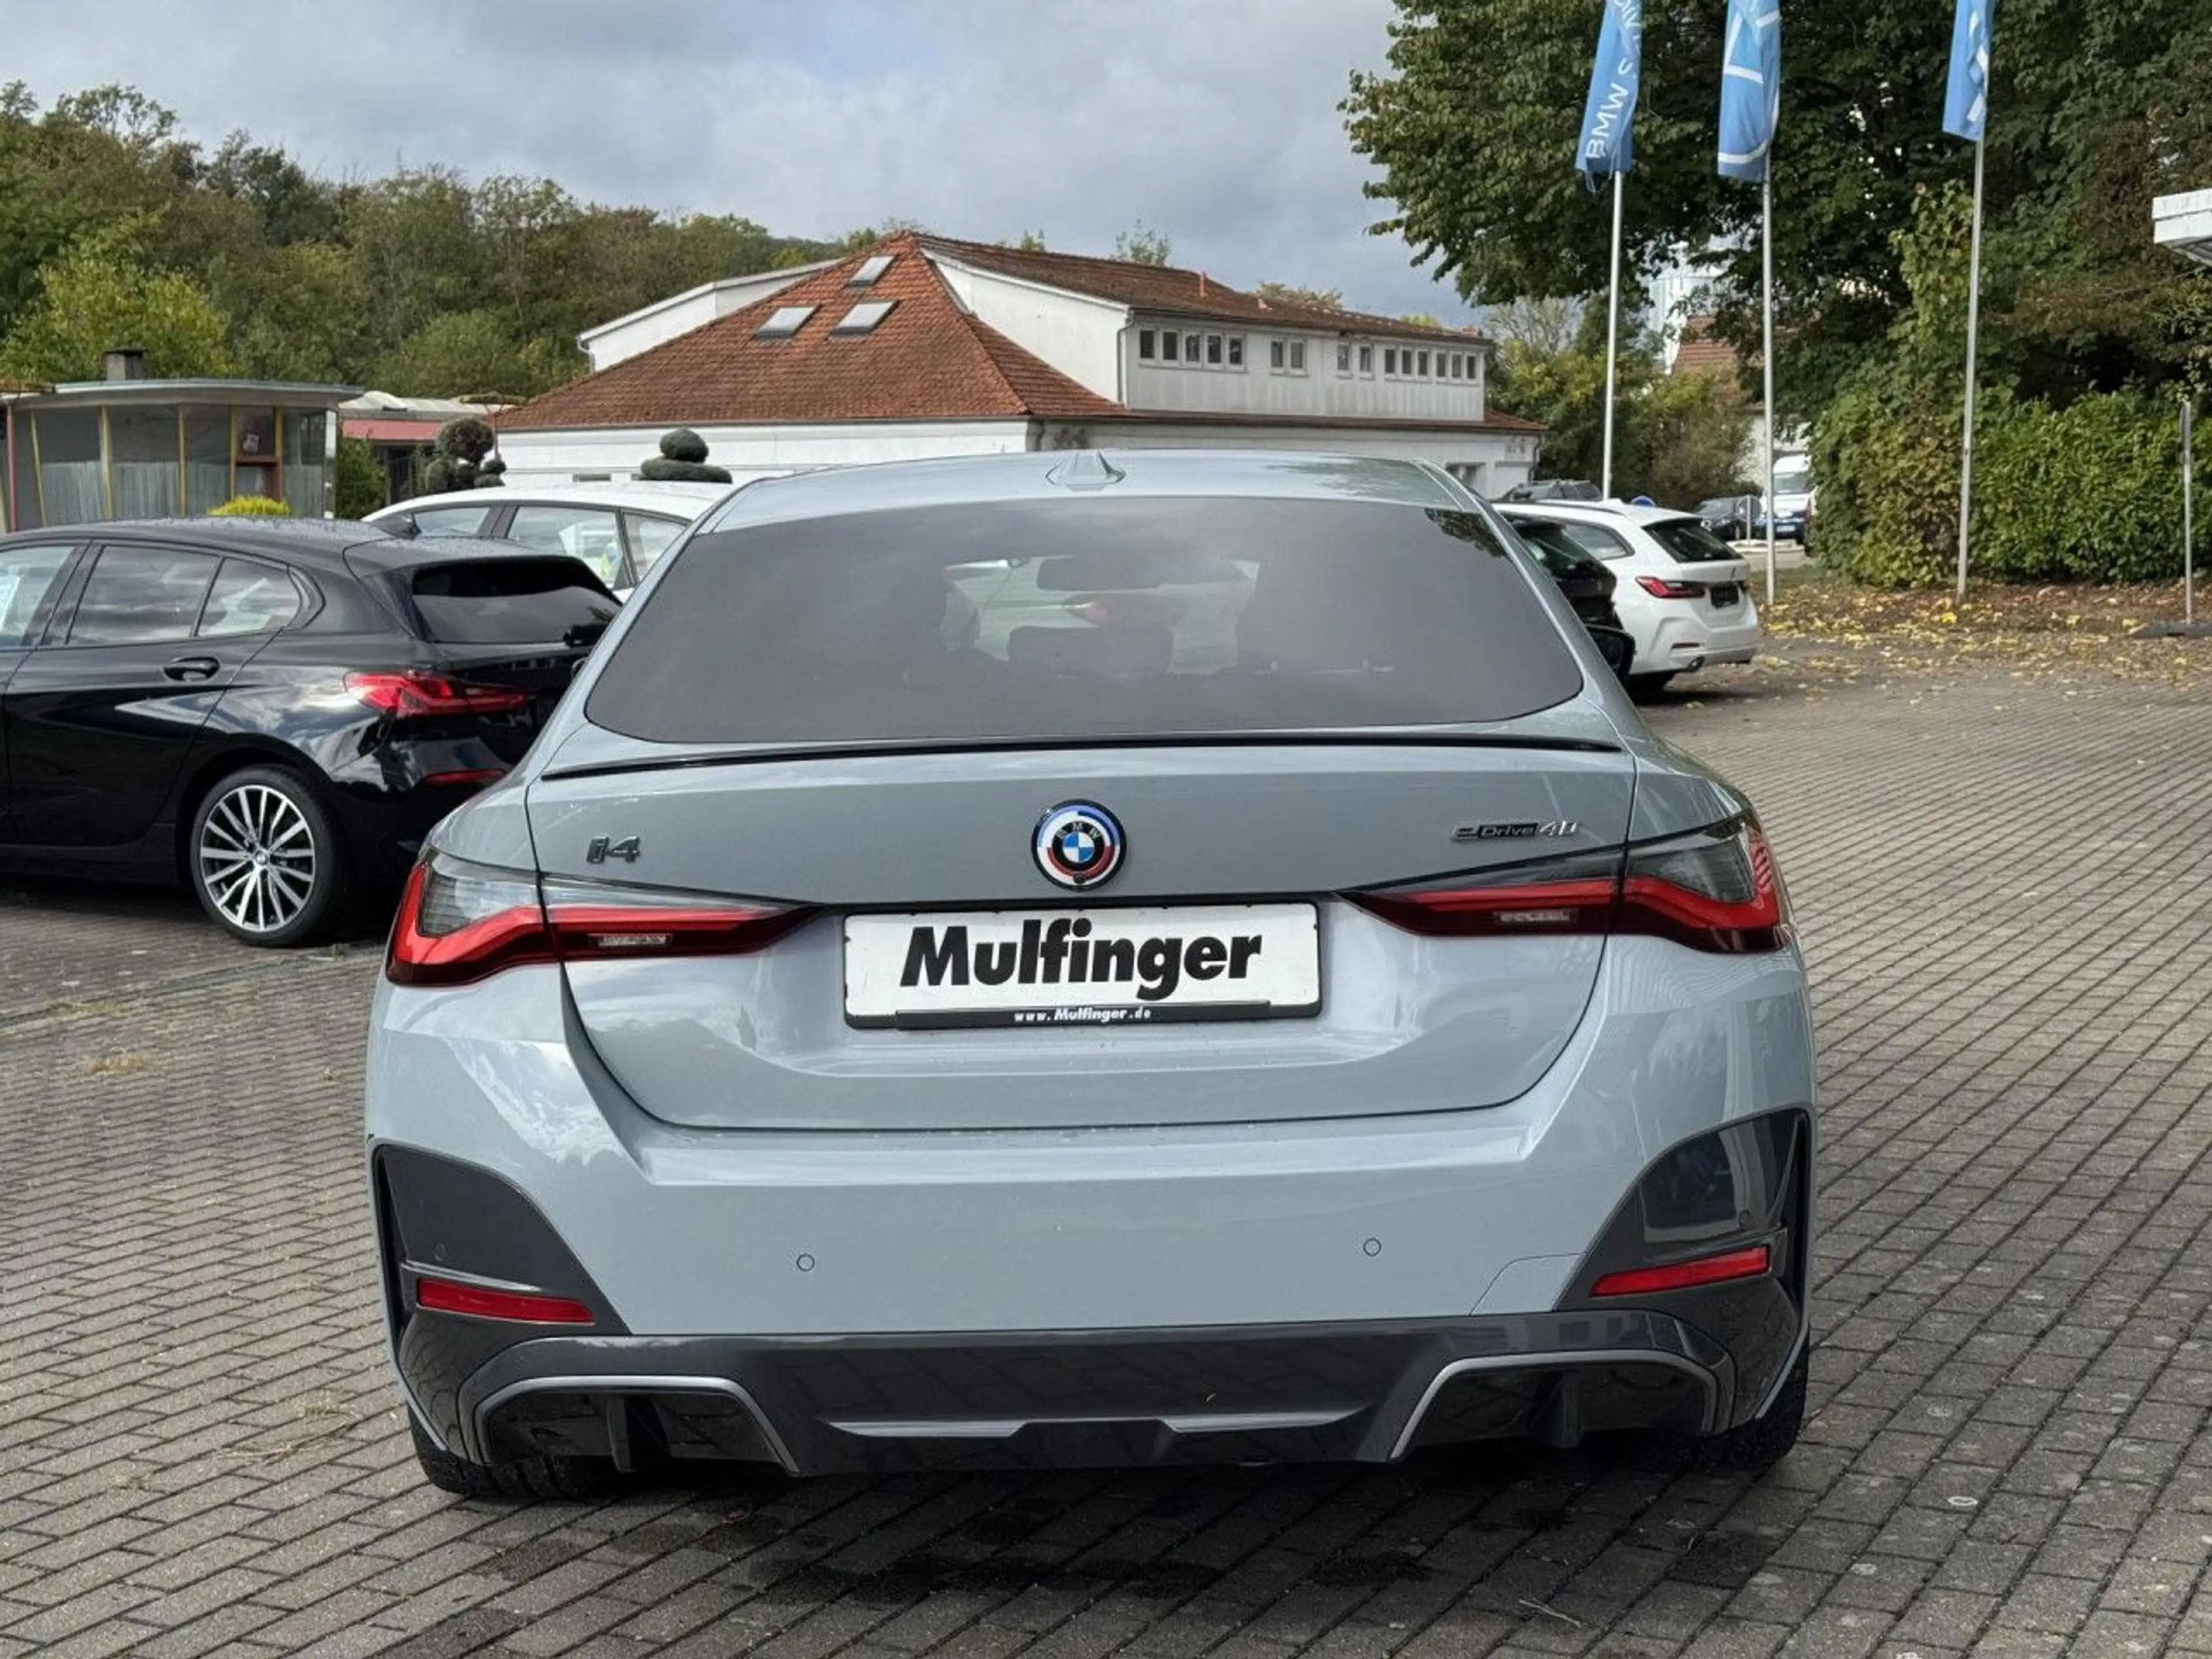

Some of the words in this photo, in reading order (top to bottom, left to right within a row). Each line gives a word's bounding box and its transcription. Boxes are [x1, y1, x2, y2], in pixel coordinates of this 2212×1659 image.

[1586, 83, 1628, 158] BMW
[1055, 821, 1102, 839] BMW
[586, 835, 641, 863] i4
[900, 918, 1262, 1001] Mulfinger
[1014, 1005, 1152, 1022] www.Mulfinger.de
